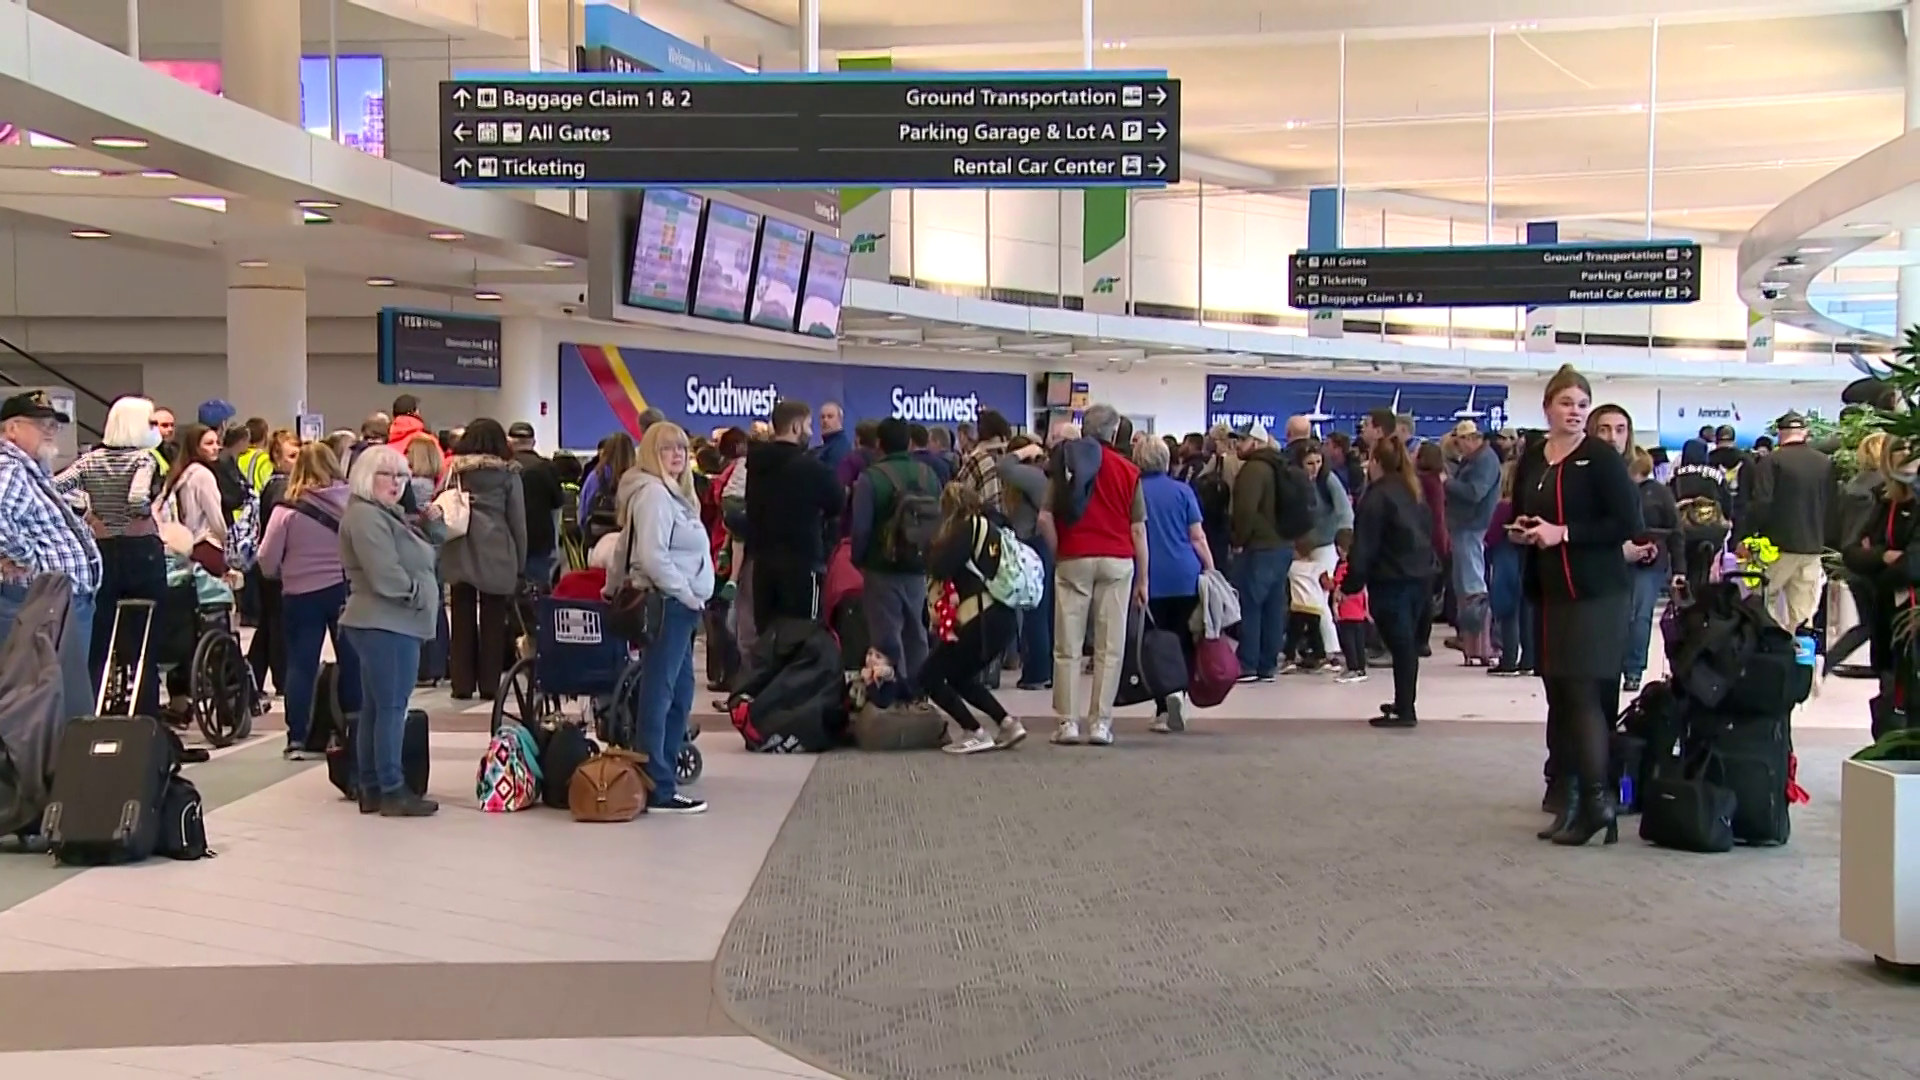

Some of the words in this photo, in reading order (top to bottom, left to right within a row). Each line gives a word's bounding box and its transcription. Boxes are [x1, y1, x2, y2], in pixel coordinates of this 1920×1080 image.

[503, 89, 583, 111] Baggage
[588, 89, 639, 107] Claim
[646, 90, 654, 107] 1
[661, 90, 675, 107] &
[680, 90, 691, 107] 2
[906, 88, 975, 106] Ground
[979, 87, 1116, 109] Transportation
[528, 123, 553, 141] All
[558, 124, 611, 142] Gates
[899, 123, 969, 145] Parking
[974, 123, 1041, 144] Garage
[1046, 123, 1061, 140] &
[1066, 123, 1096, 140] Lot
[1100, 123, 1116, 140] A
[502, 158, 585, 180] Ticketing
[953, 157, 1012, 175] Rental
[1017, 158, 1049, 175] Car
[1053, 157, 1116, 175] Center
[1322, 257, 1336, 267] All
[1338, 257, 1367, 267] Gates
[1543, 252, 1583, 263] Ground
[1585, 250, 1664, 263] Transportation
[1322, 275, 1367, 287] Ticketing
[1581, 270, 1622, 283] Parking
[1623, 270, 1663, 283] Garage
[1321, 294, 1365, 305] Baggage
[1366, 293, 1395, 303] Claim
[1398, 293, 1404, 303] 1
[1406, 293, 1415, 303] &
[1416, 292, 1423, 303] 2
[1569, 288, 1604, 300] Rental
[1605, 288, 1625, 299] Car
[1626, 288, 1663, 299] Center
[685, 376, 776, 415] Southwest
[891, 386, 977, 422] Southwest
[1698, 406, 1730, 418] American
